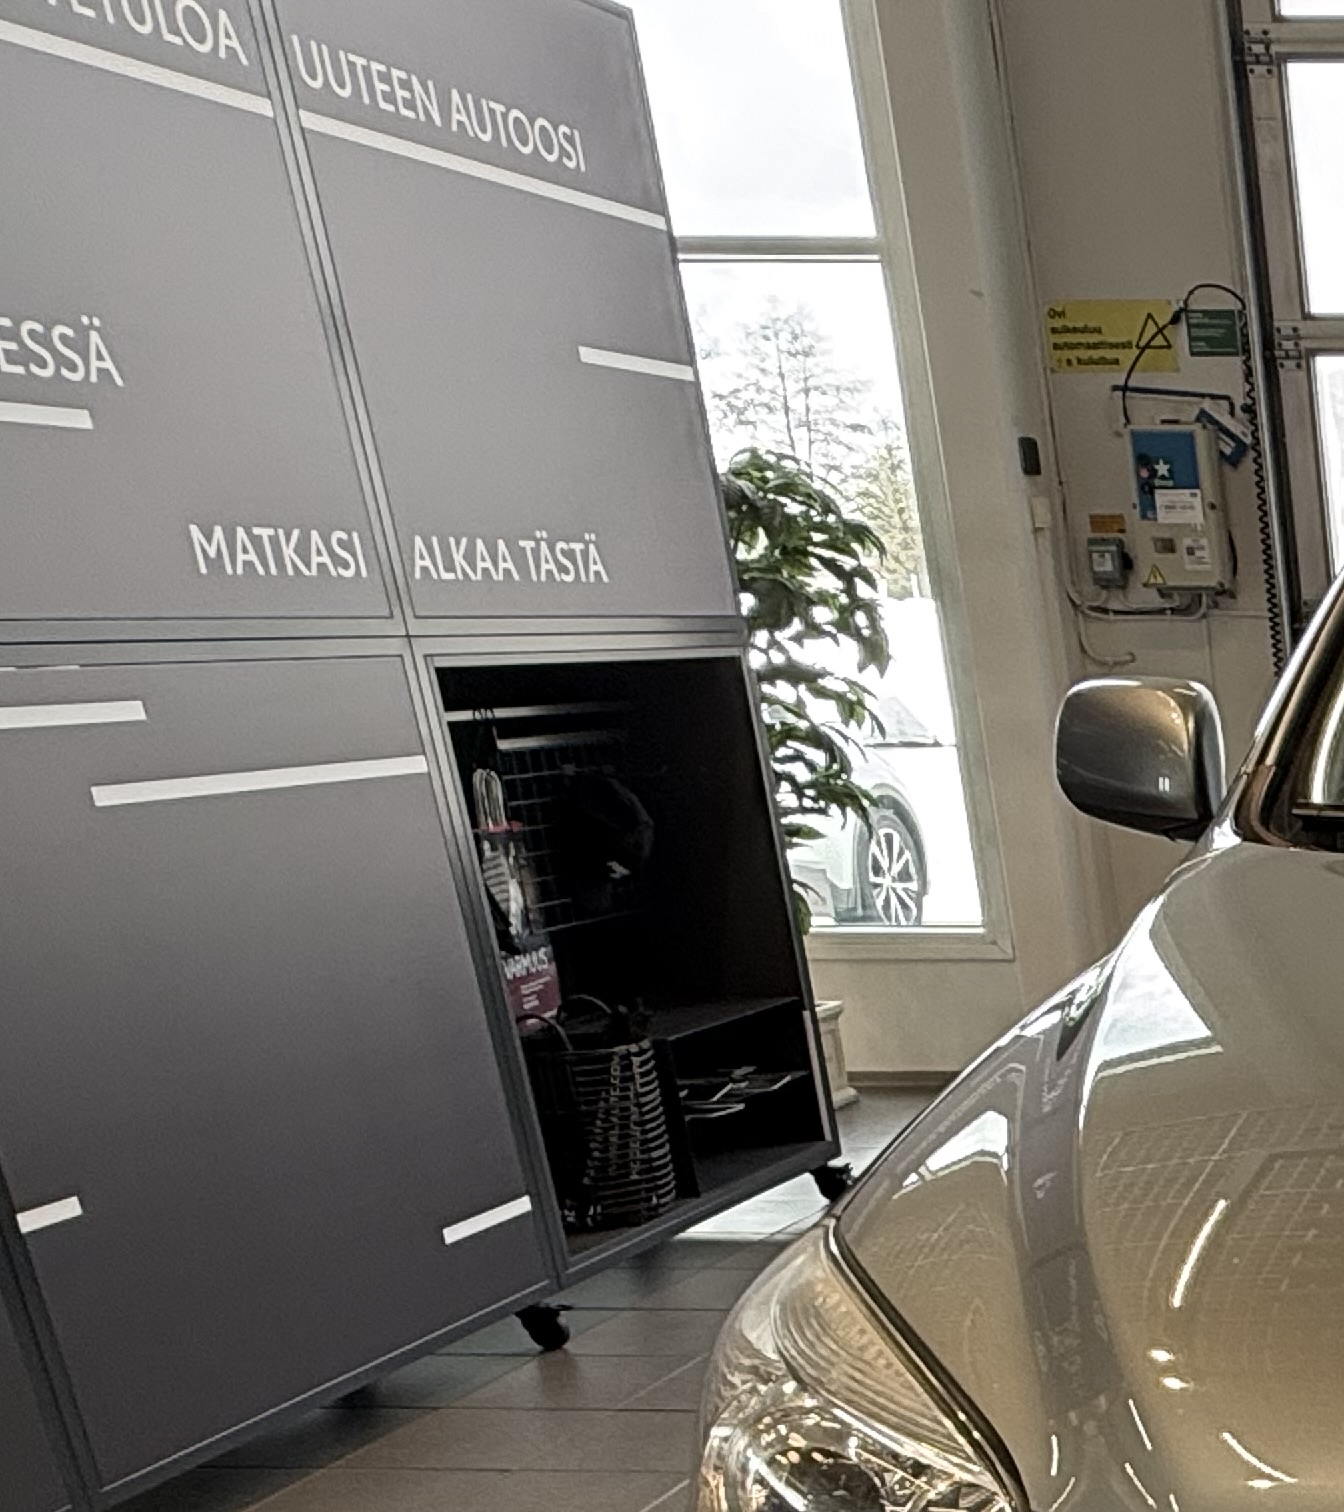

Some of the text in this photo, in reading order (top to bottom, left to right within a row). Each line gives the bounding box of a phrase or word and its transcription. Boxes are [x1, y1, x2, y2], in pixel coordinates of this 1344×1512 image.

[291, 34, 442, 127] UUTEEN
[450, 88, 586, 172] AUTOOSI
[189, 524, 609, 583] MATKASI ALKAA TÄSTÄ
